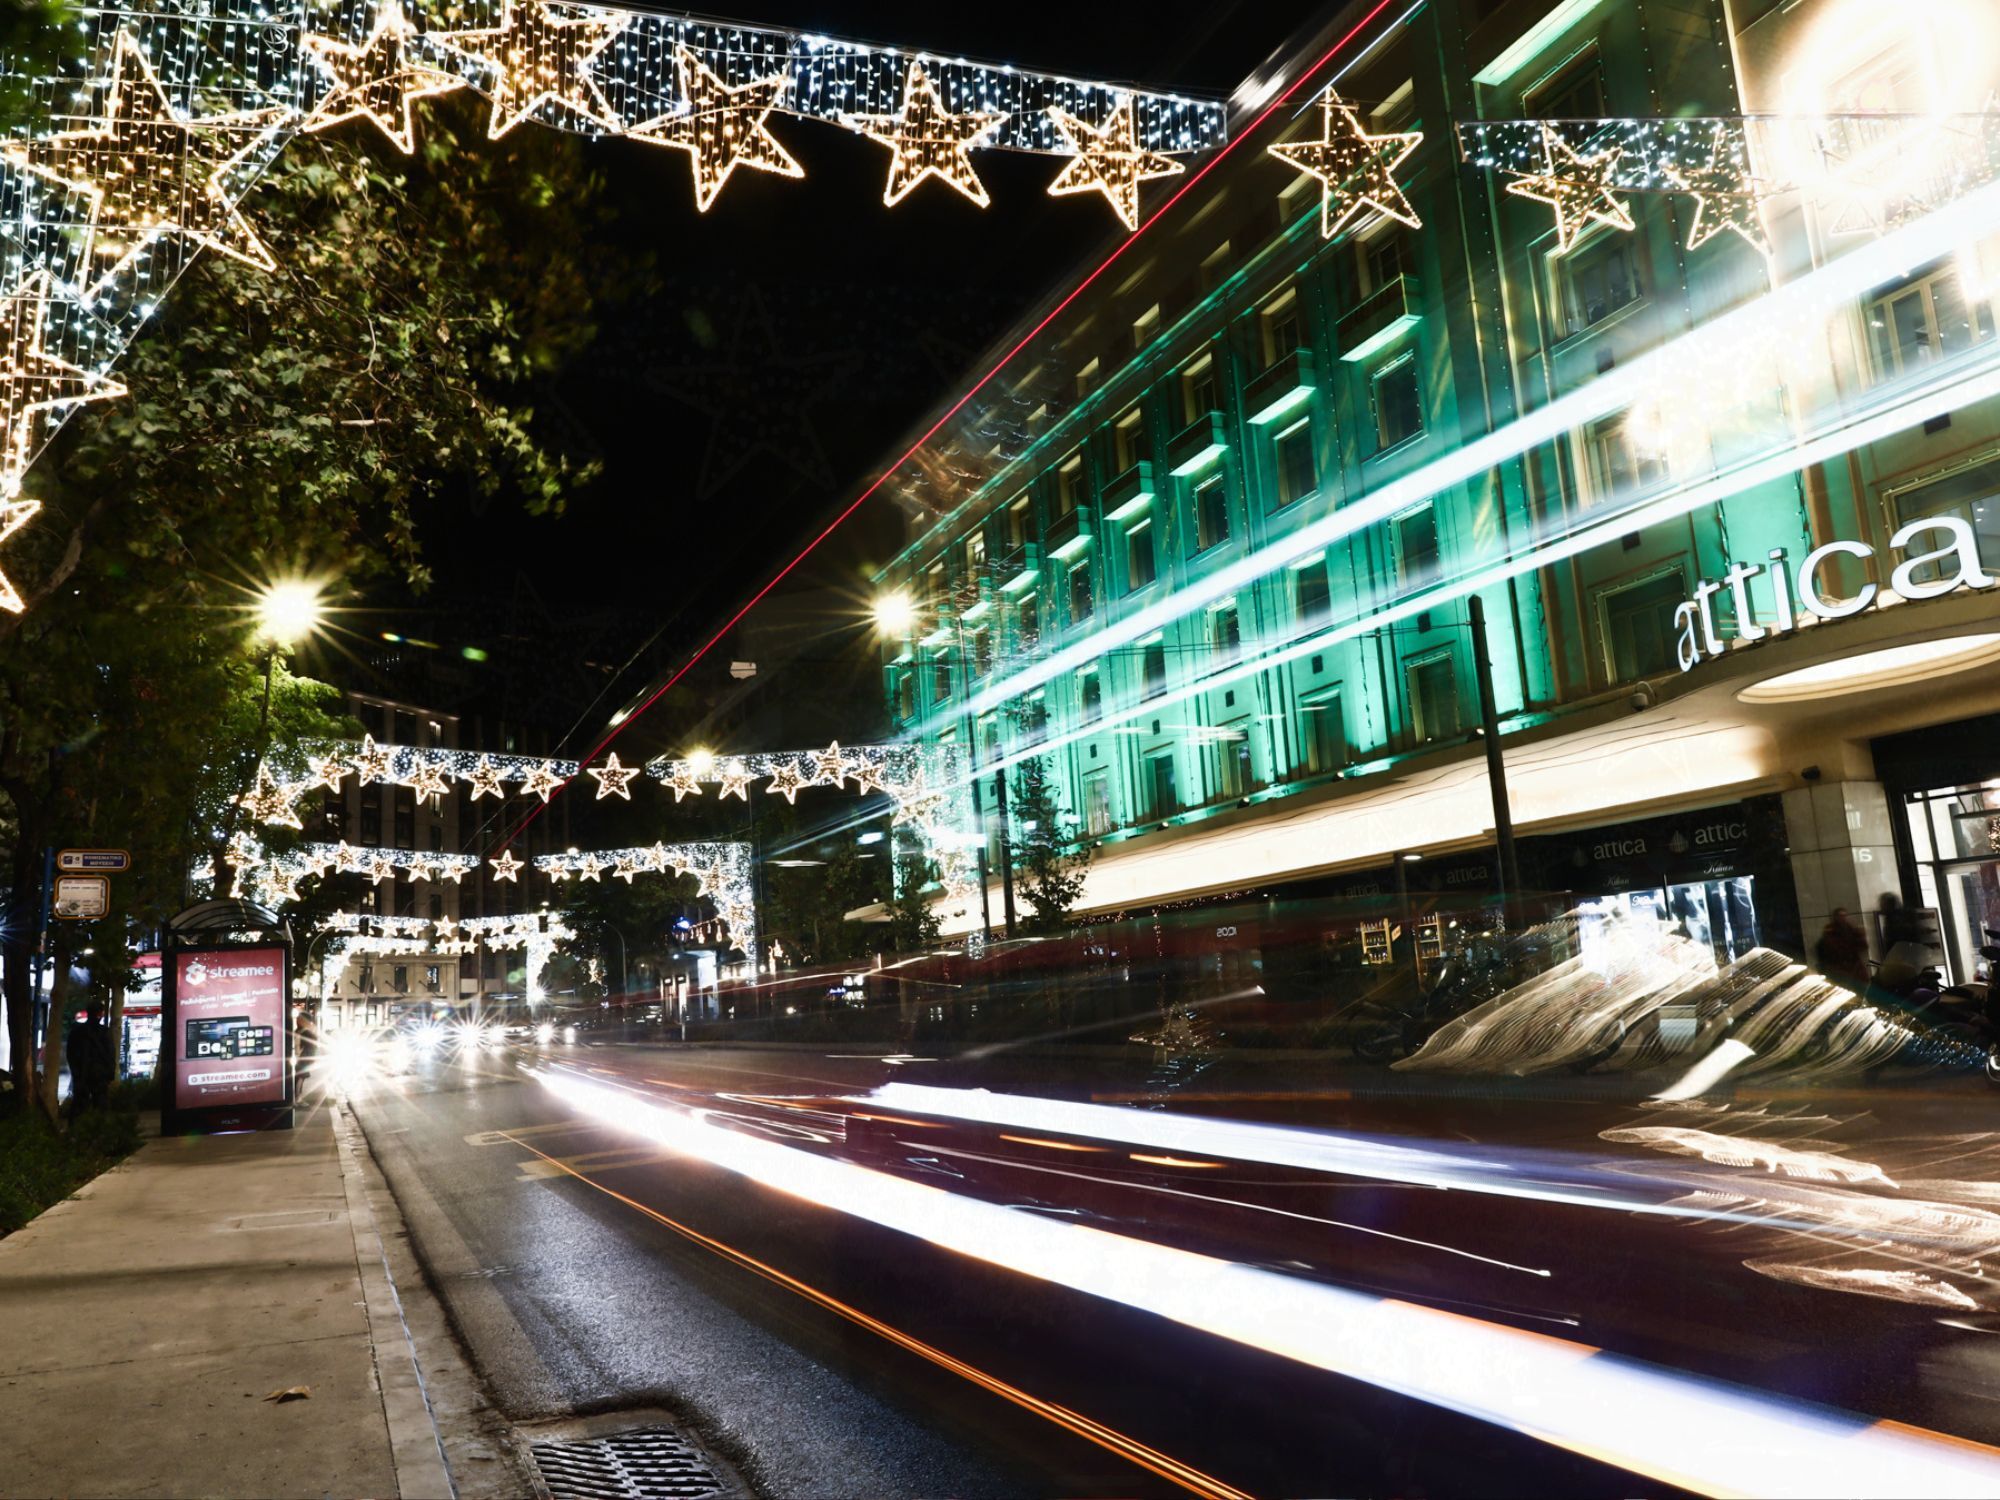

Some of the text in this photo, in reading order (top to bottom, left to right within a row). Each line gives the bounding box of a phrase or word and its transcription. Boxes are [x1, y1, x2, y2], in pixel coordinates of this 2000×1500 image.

[1674, 516, 1995, 673] attica
[1593, 838, 1647, 861] attica
[1446, 865, 1488, 884] attica
[1345, 881, 1380, 899] attica
[210, 965, 274, 978] streamee
[200, 1071, 267, 1081] streamee.com
